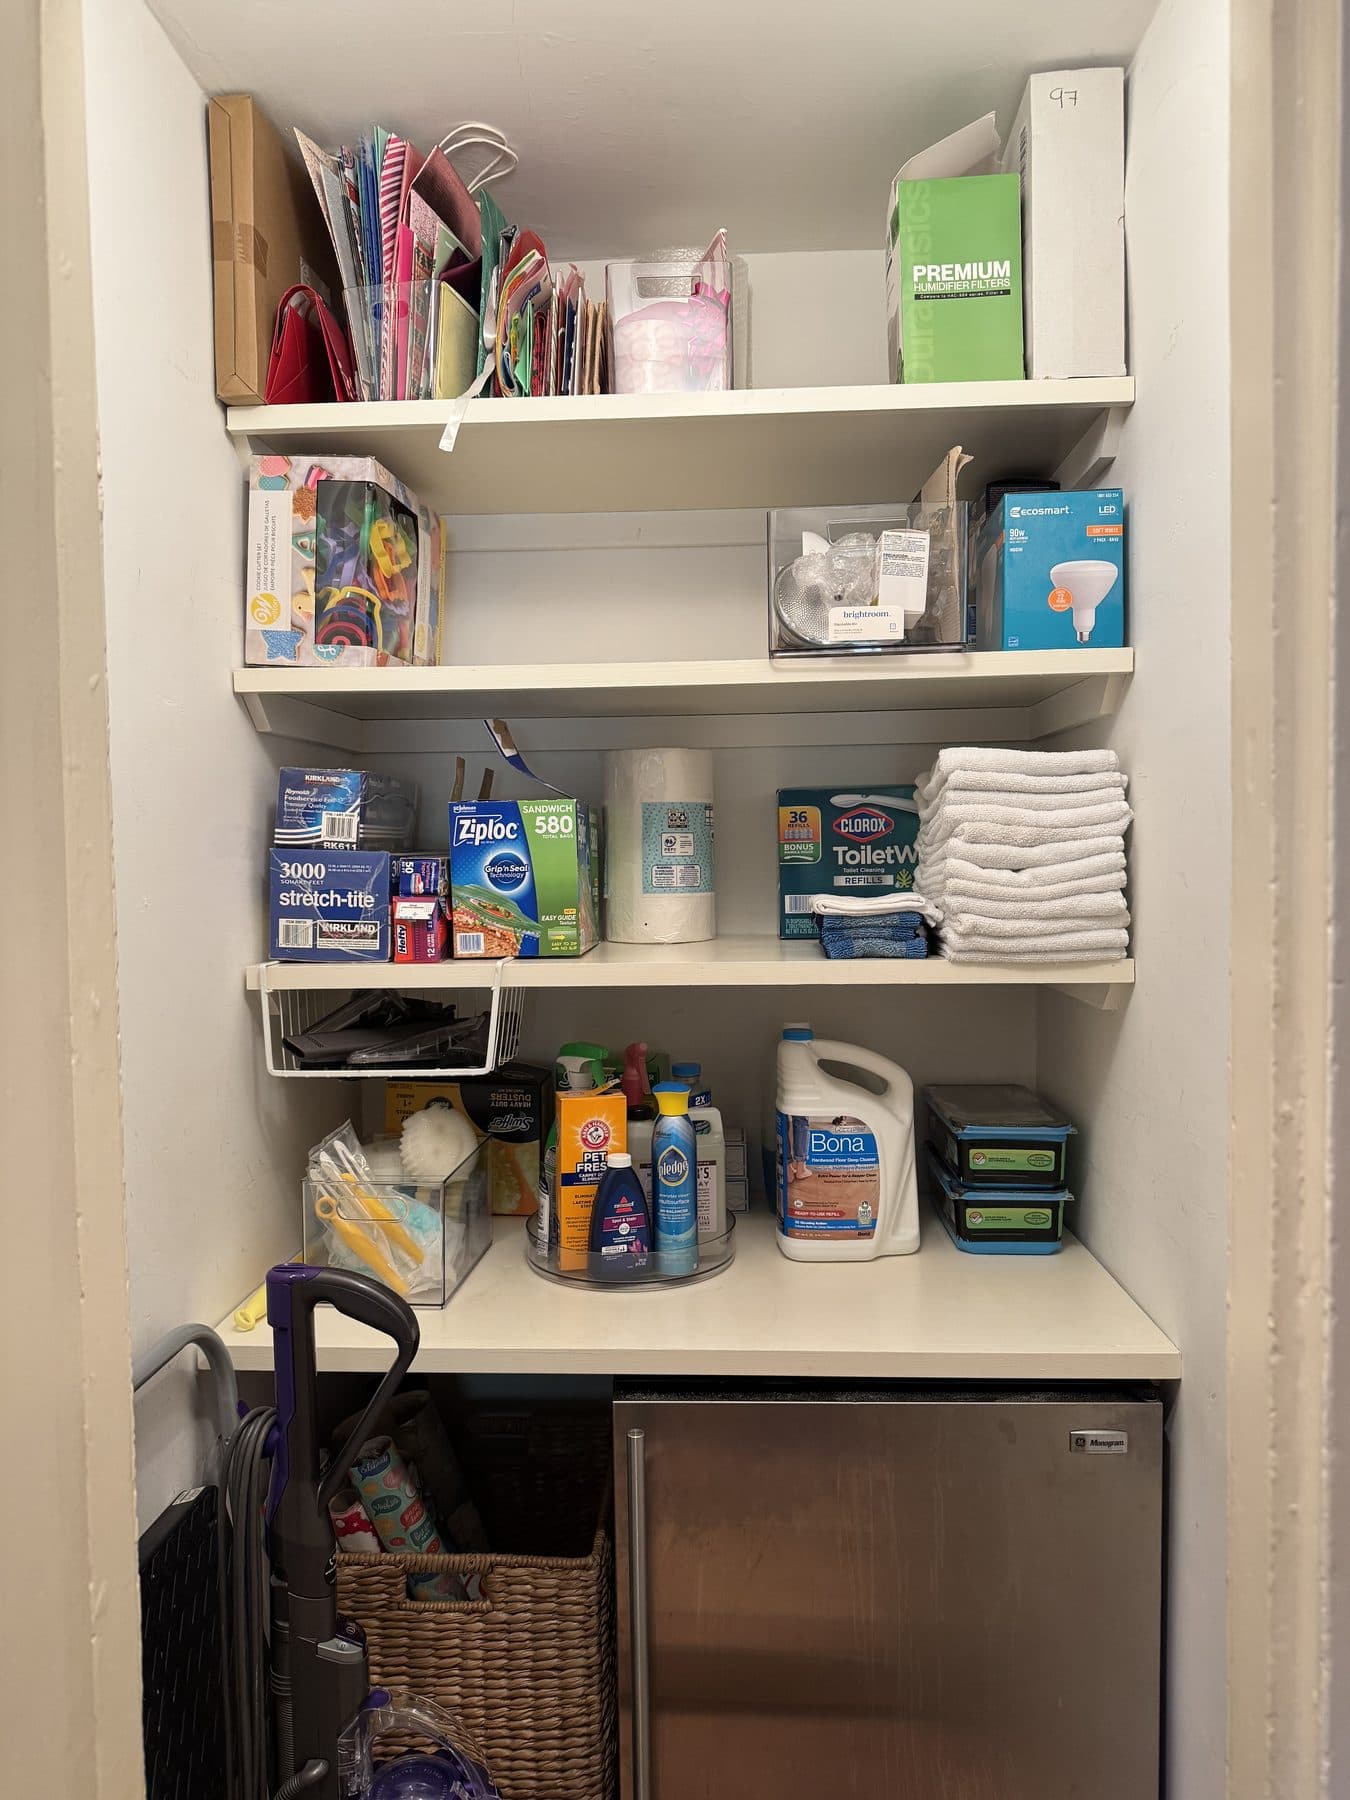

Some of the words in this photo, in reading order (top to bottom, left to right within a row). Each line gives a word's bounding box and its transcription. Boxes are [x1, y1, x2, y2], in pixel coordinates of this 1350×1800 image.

[1049, 87, 1077, 109] 97
[912, 260, 1010, 282] PREMIUM
[914, 281, 970, 292] HUMIDIFIER
[971, 278, 1010, 289] FILTERS
[1020, 506, 1070, 516] ecosmart
[1099, 506, 1116, 514] LED
[843, 610, 889, 619] brightroom
[522, 805, 572, 814] SANDWICH
[789, 811, 808, 824] 36
[535, 815, 572, 834] 580
[841, 818, 885, 832] CLOROX
[460, 818, 518, 846] Ziploc
[324, 841, 356, 850] RK611
[280, 862, 326, 879] 3000
[405, 862, 414, 874] 50
[510, 864, 528, 872] Seal
[845, 876, 882, 884] REFILLS
[279, 890, 374, 908] stretch-tite
[398, 926, 406, 953] Hefty
[427, 948, 435, 957] 12
[695, 1095, 706, 1105] 2X
[811, 1133, 864, 1152] Bona
[584, 1152, 606, 1162] PET
[659, 1161, 688, 1176] pledge
[1090, 1440, 1124, 1448] Monogram
